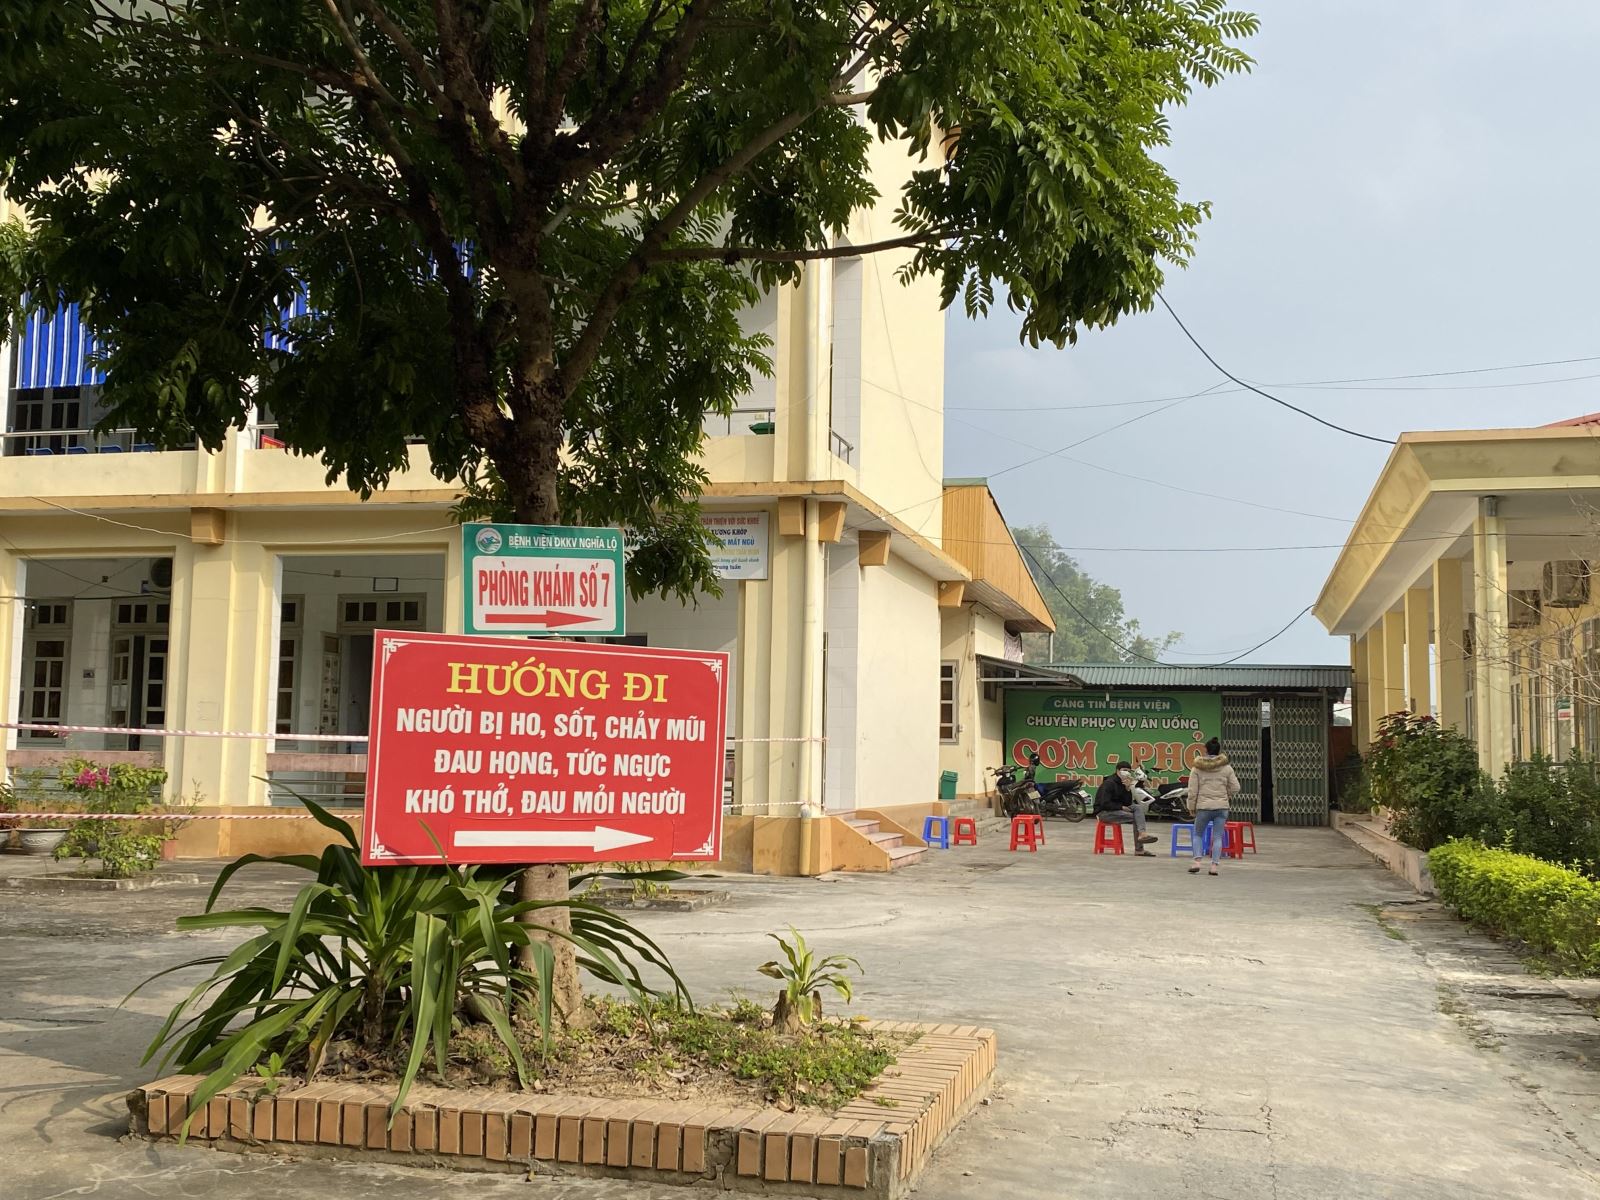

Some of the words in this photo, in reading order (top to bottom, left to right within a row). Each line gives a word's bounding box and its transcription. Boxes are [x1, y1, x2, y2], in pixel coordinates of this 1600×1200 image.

[508, 533, 531, 550] BỆNH
[534, 534, 552, 550] VIỆN
[554, 536, 577, 548] ĐKKV
[578, 536, 605, 548] NGHĨA
[606, 537, 618, 552] LỘ
[478, 561, 529, 606] PHÒNG
[534, 564, 574, 607] KHÁM
[580, 562, 598, 608] SỐ
[601, 572, 610, 608] 7
[446, 656, 611, 700] HƯỚNG
[622, 672, 669, 703] ĐI
[1026, 714, 1078, 728] CHUYÊN
[1081, 717, 1116, 730] PHỤC
[1119, 718, 1137, 731] VỤ
[1140, 716, 1158, 730] ĂN
[1162, 715, 1200, 730] UỐNG
[1088, 700, 1106, 709] TIN
[1109, 699, 1140, 711] BỆNH
[1143, 700, 1170, 712] VIỆN
[396, 704, 472, 734] NGƯỜI
[479, 710, 503, 740] BỊ
[510, 713, 546, 739] HO,
[554, 706, 598, 741] SỐT,
[605, 710, 661, 740] CHẢY
[666, 718, 706, 742] MŨI
[434, 750, 482, 774] ĐAU
[489, 752, 559, 780] HỌNG,
[566, 748, 606, 776] TỨC
[613, 753, 671, 782] NGỰC
[1012, 736, 1098, 770] CƠM
[404, 785, 455, 814] KHÓ
[462, 782, 514, 817] THỞ,
[521, 791, 566, 814] ĐAU
[572, 785, 614, 814] MỎI
[621, 787, 686, 815] NGƯỜI
